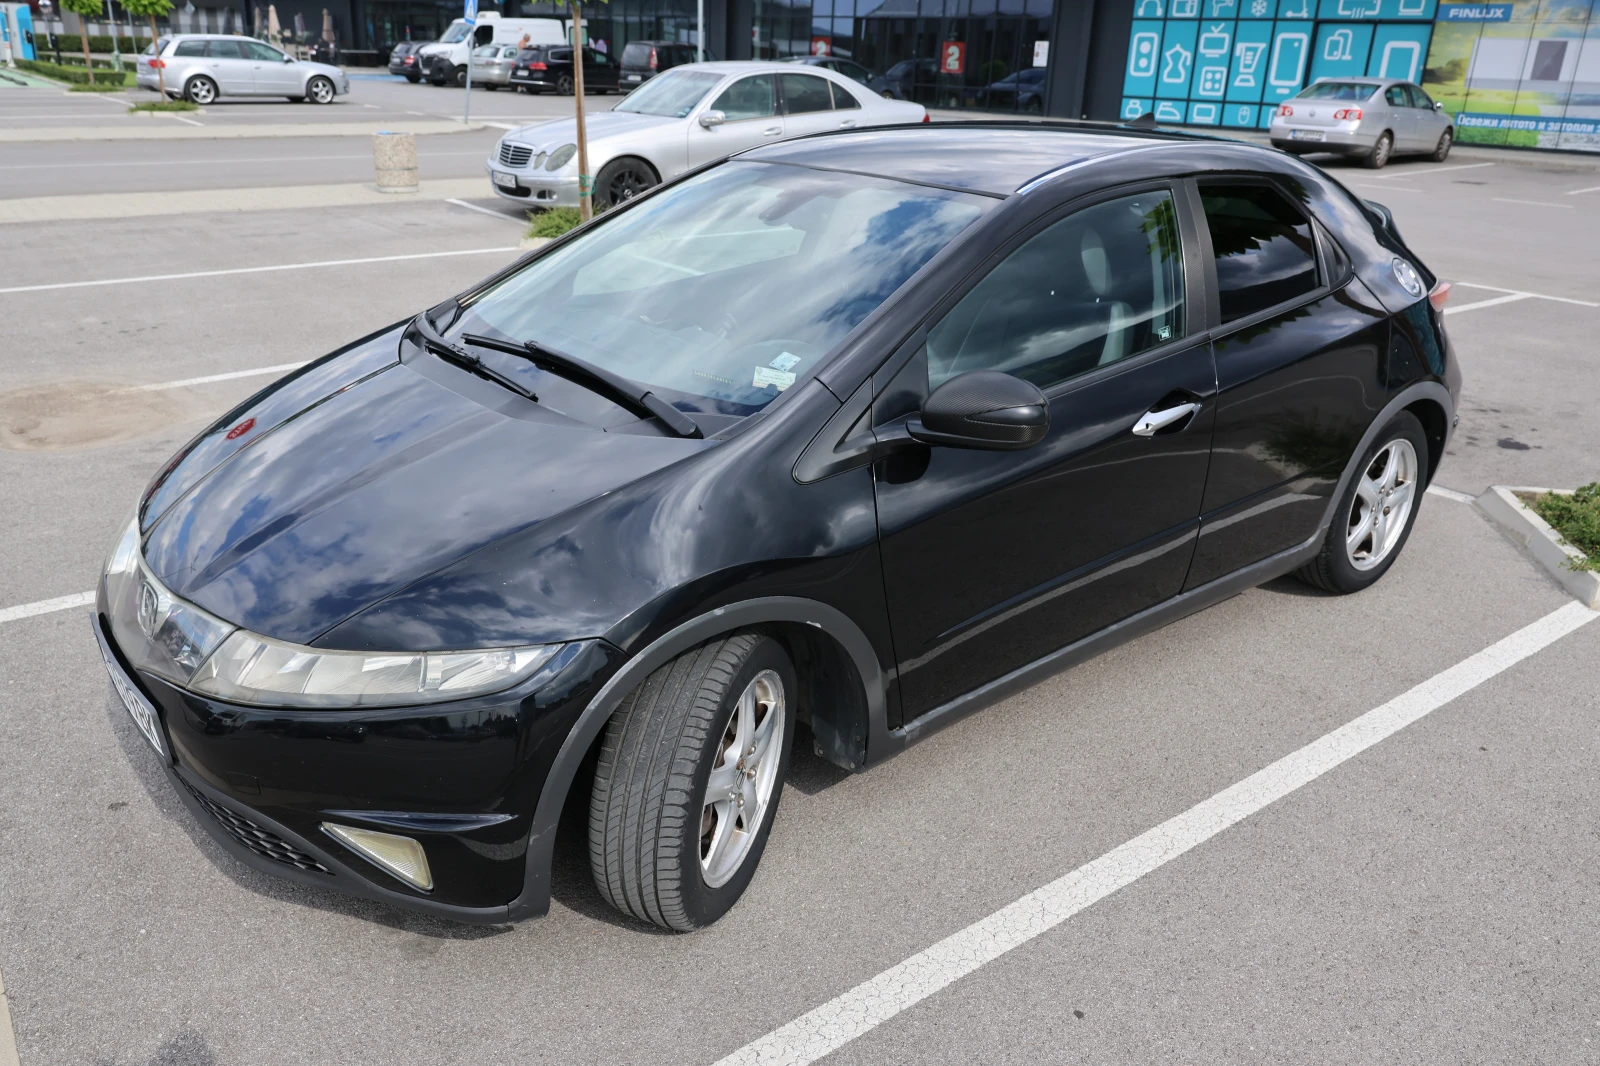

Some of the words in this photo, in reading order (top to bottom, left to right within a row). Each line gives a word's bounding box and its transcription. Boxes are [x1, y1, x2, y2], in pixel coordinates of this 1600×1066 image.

[1449, 8, 1504, 18] FINLUX
[816, 40, 827, 57] 2
[946, 45, 960, 69] 2
[1457, 114, 1498, 126] Освежи
[1538, 121, 1545, 130] и
